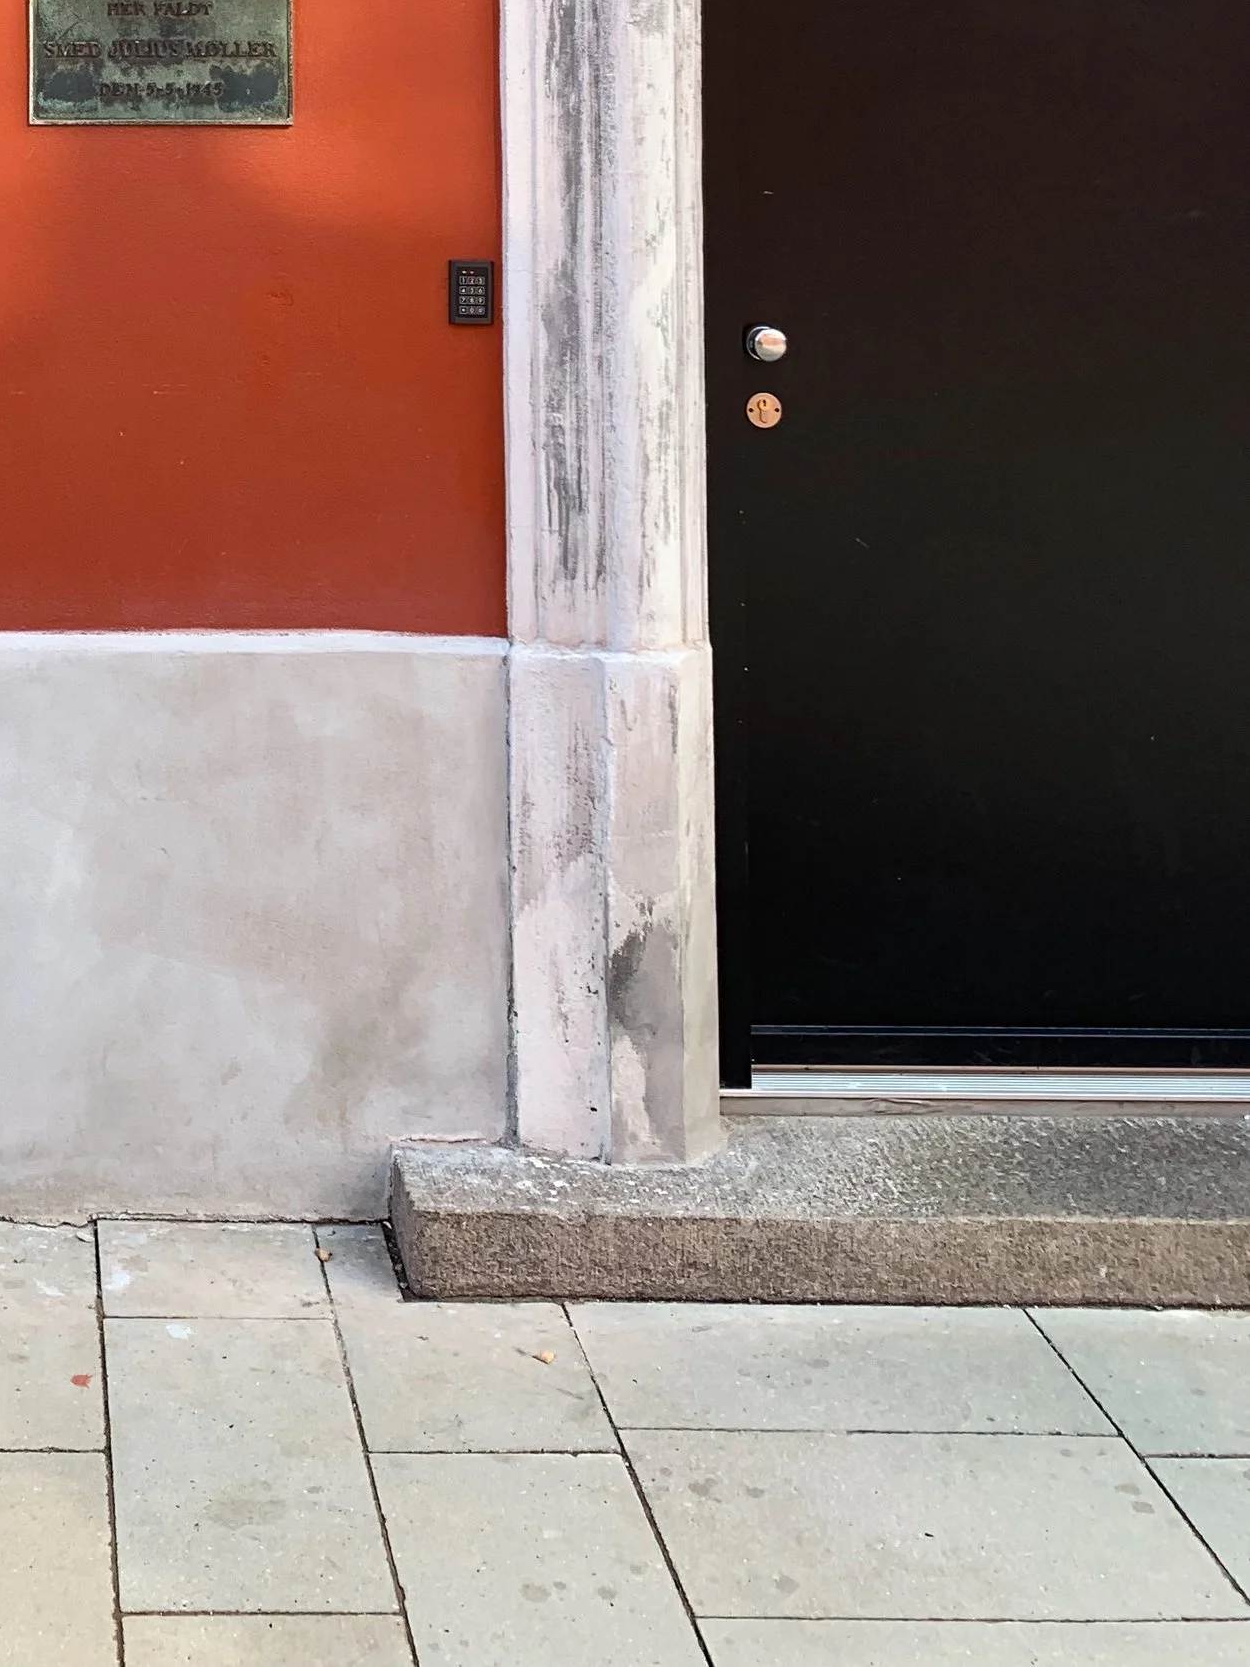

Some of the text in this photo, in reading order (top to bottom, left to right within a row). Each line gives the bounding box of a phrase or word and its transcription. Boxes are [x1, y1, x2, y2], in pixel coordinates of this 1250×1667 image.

[107, 1, 213, 17] HER FALDT
[43, 39, 277, 58] SMED JULIUS MØLLER
[99, 82, 139, 97] DEN
